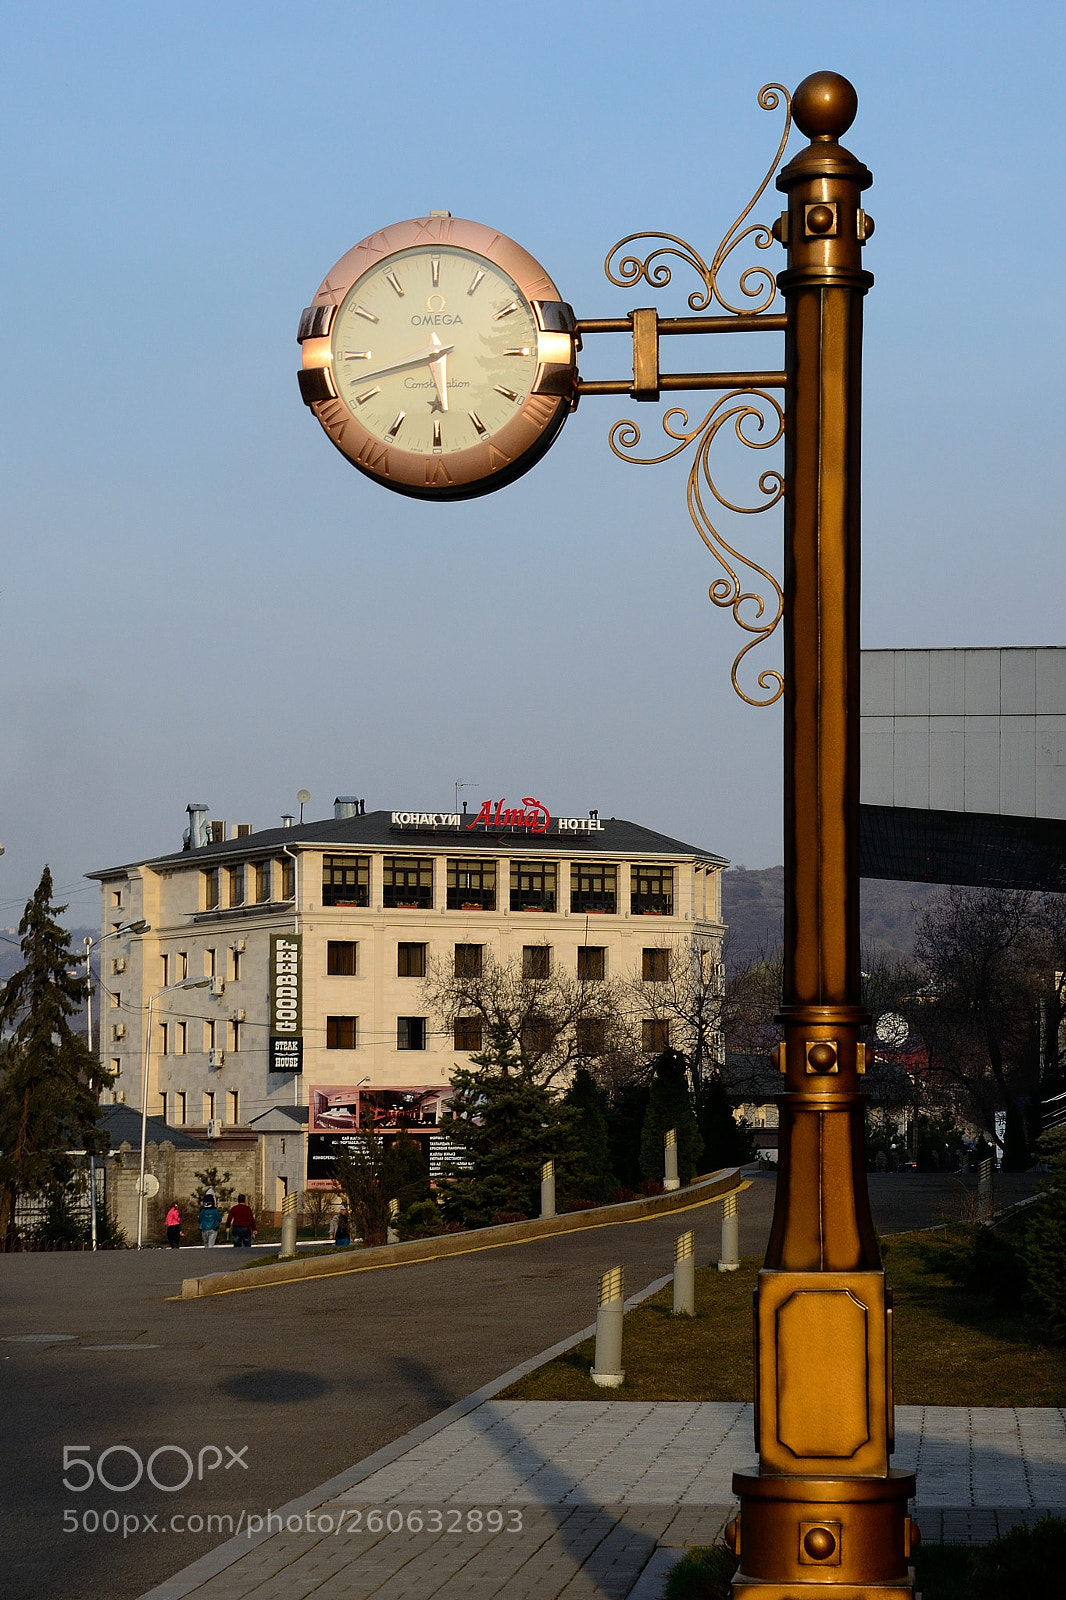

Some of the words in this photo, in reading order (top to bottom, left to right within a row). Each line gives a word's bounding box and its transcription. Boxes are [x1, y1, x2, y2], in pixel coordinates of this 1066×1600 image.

[410, 314, 464, 326] OMEGA
[404, 377, 470, 389] Consteation
[466, 797, 551, 833] Alma
[558, 818, 605, 831] HOTEL
[275, 939, 298, 1032] GOODBEEF
[274, 1041, 299, 1051] STEAK
[274, 1057, 299, 1067] HOUSE
